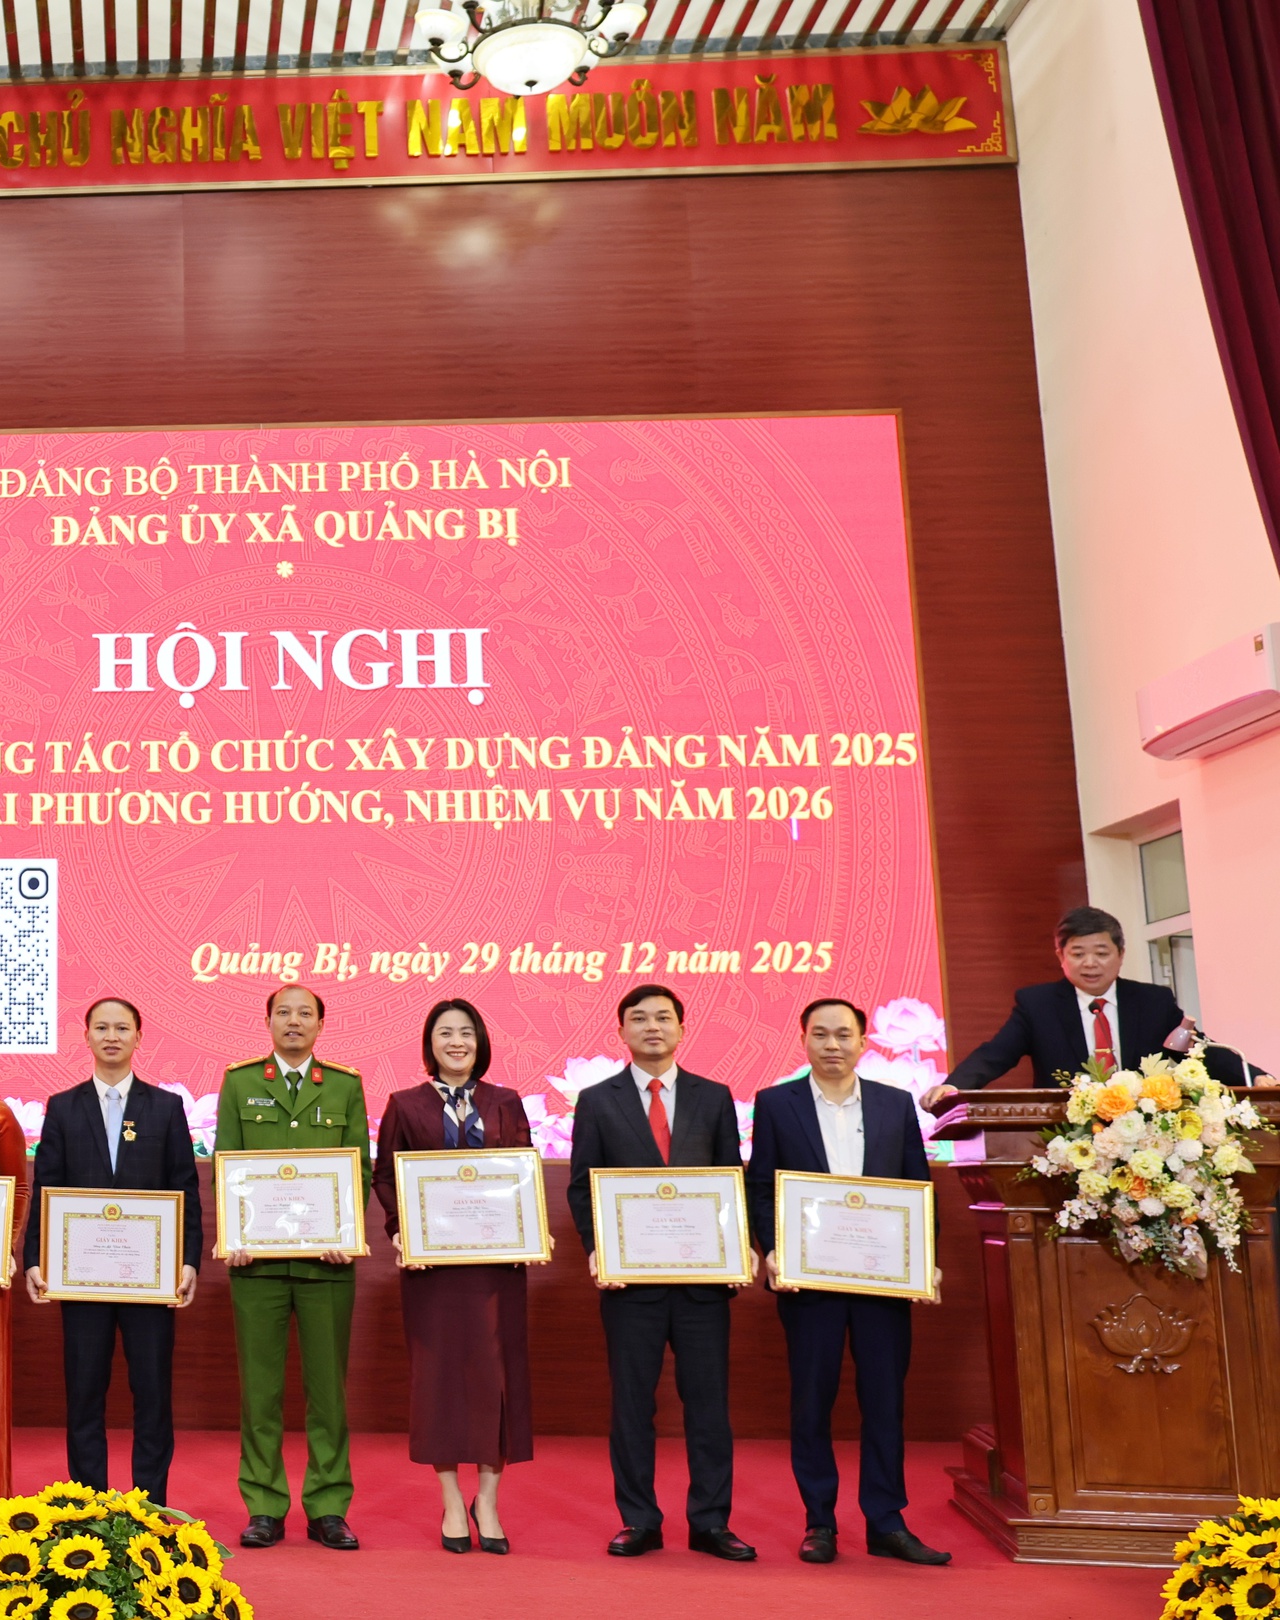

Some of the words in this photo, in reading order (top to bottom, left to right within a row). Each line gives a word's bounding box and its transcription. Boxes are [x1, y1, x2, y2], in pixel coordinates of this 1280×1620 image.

[110, 92, 263, 165] NGHĨA
[277, 88, 385, 170] VIỆT
[406, 95, 528, 157] NAM
[545, 77, 699, 152] MUÔN
[711, 73, 839, 146] NĂM
[122, 457, 179, 501] BỘ
[187, 454, 329, 496] THÀNH
[338, 451, 421, 494] PHỐ
[429, 455, 494, 492] HÀ
[498, 449, 572, 494] NỘI
[51, 506, 170, 547] ĐẢNG
[180, 503, 235, 545] ỦY
[244, 503, 304, 544] XÃ
[313, 500, 466, 548] QUẢNG
[476, 506, 521, 547] BỊ
[91, 621, 250, 709] HỘI
[270, 626, 492, 706] NGHỊ
[45, 732, 131, 774] TÁC
[140, 730, 202, 773] TỔ
[210, 731, 335, 773] CHỨC
[345, 728, 437, 771] XÂY
[443, 730, 572, 779] DỰNG
[582, 725, 707, 769] ĐẢNG
[718, 725, 821, 767] NĂM
[830, 731, 918, 767] 2025
[29, 786, 212, 826] PHƯƠNG
[222, 783, 395, 829] HƯỚNG,
[403, 784, 552, 830] NHIỆM
[561, 787, 621, 830] VỤ
[633, 779, 736, 821] NĂM
[746, 785, 834, 821] 2026
[190, 941, 304, 983] Quảng
[312, 942, 359, 980] Bị,
[369, 941, 451, 983] ngày
[459, 942, 500, 974] 29
[508, 941, 608, 983] tháng
[617, 942, 655, 974] 12
[666, 940, 741, 974] năm
[750, 939, 835, 974] 2025
